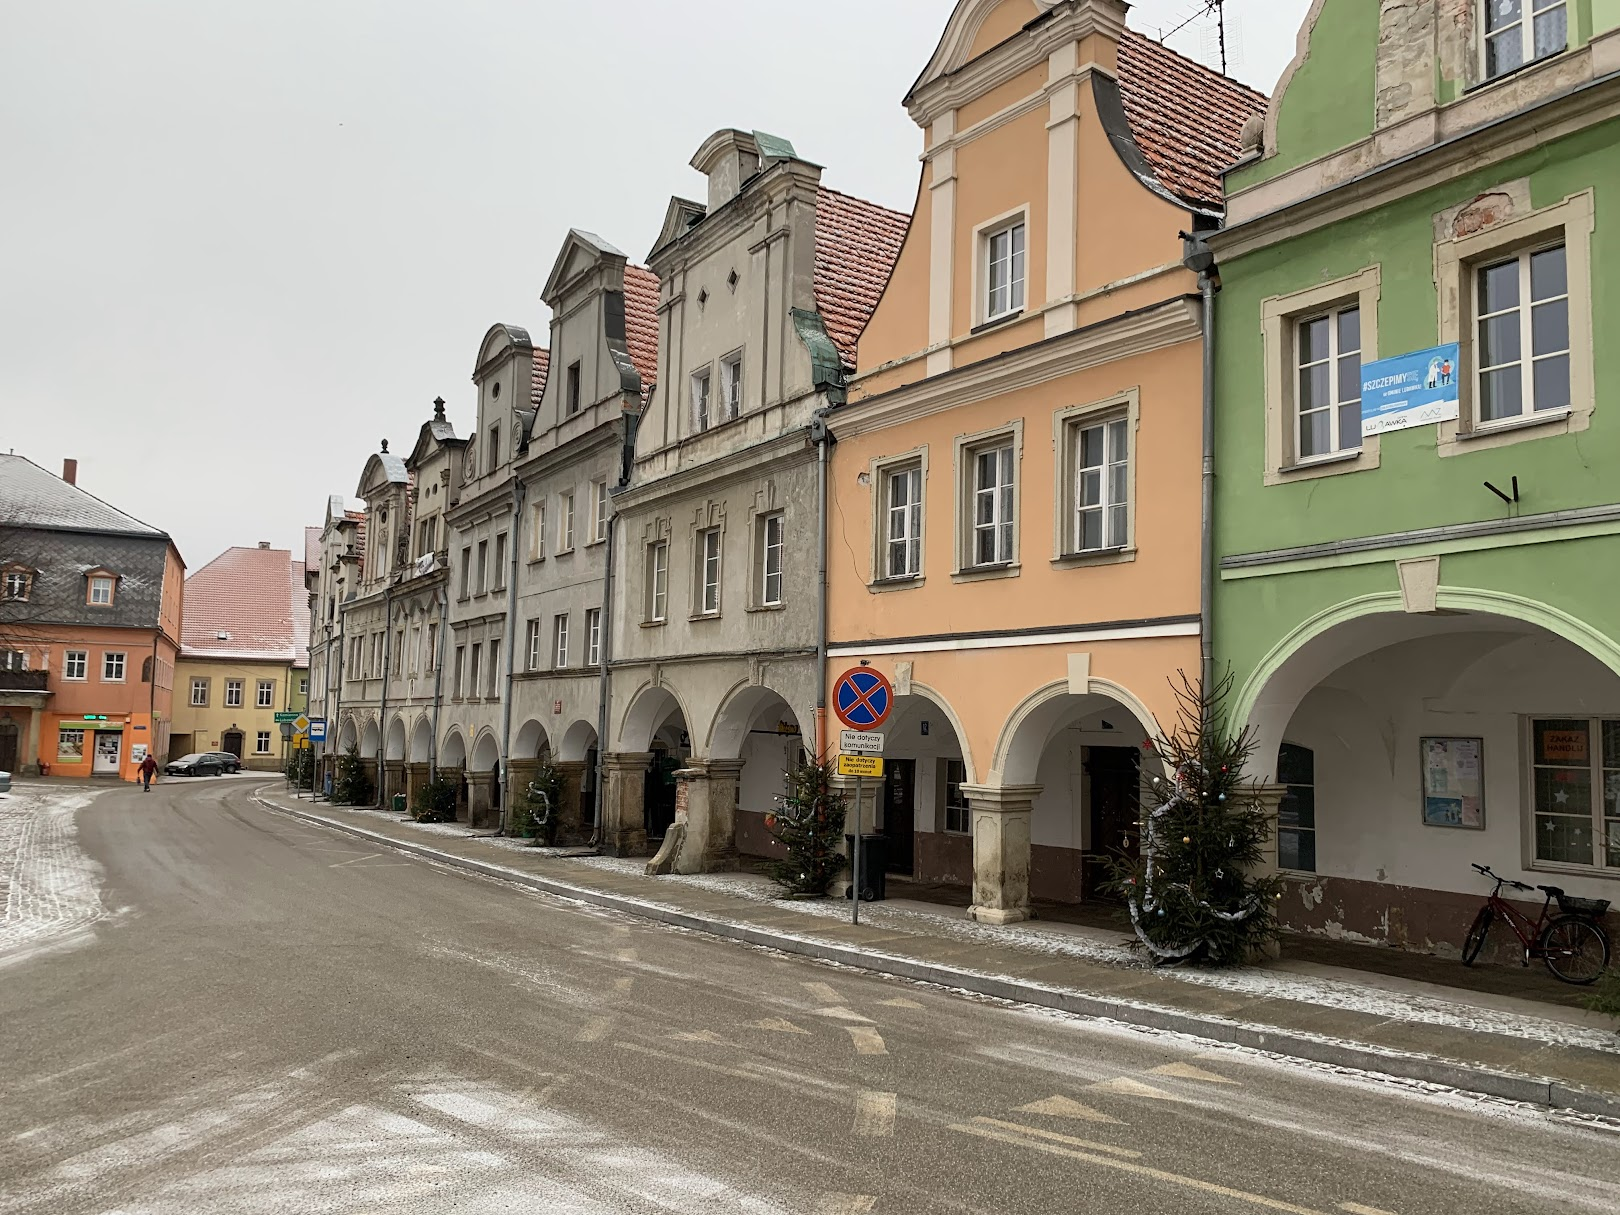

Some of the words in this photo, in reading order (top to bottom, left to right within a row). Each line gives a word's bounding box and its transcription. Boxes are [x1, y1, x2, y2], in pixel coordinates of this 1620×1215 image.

[857, 734, 881, 742] dotyczy
[1549, 735, 1580, 743] ZAKAZ
[844, 742, 881, 750] komunikacji
[1546, 744, 1584, 752] HANDLU
